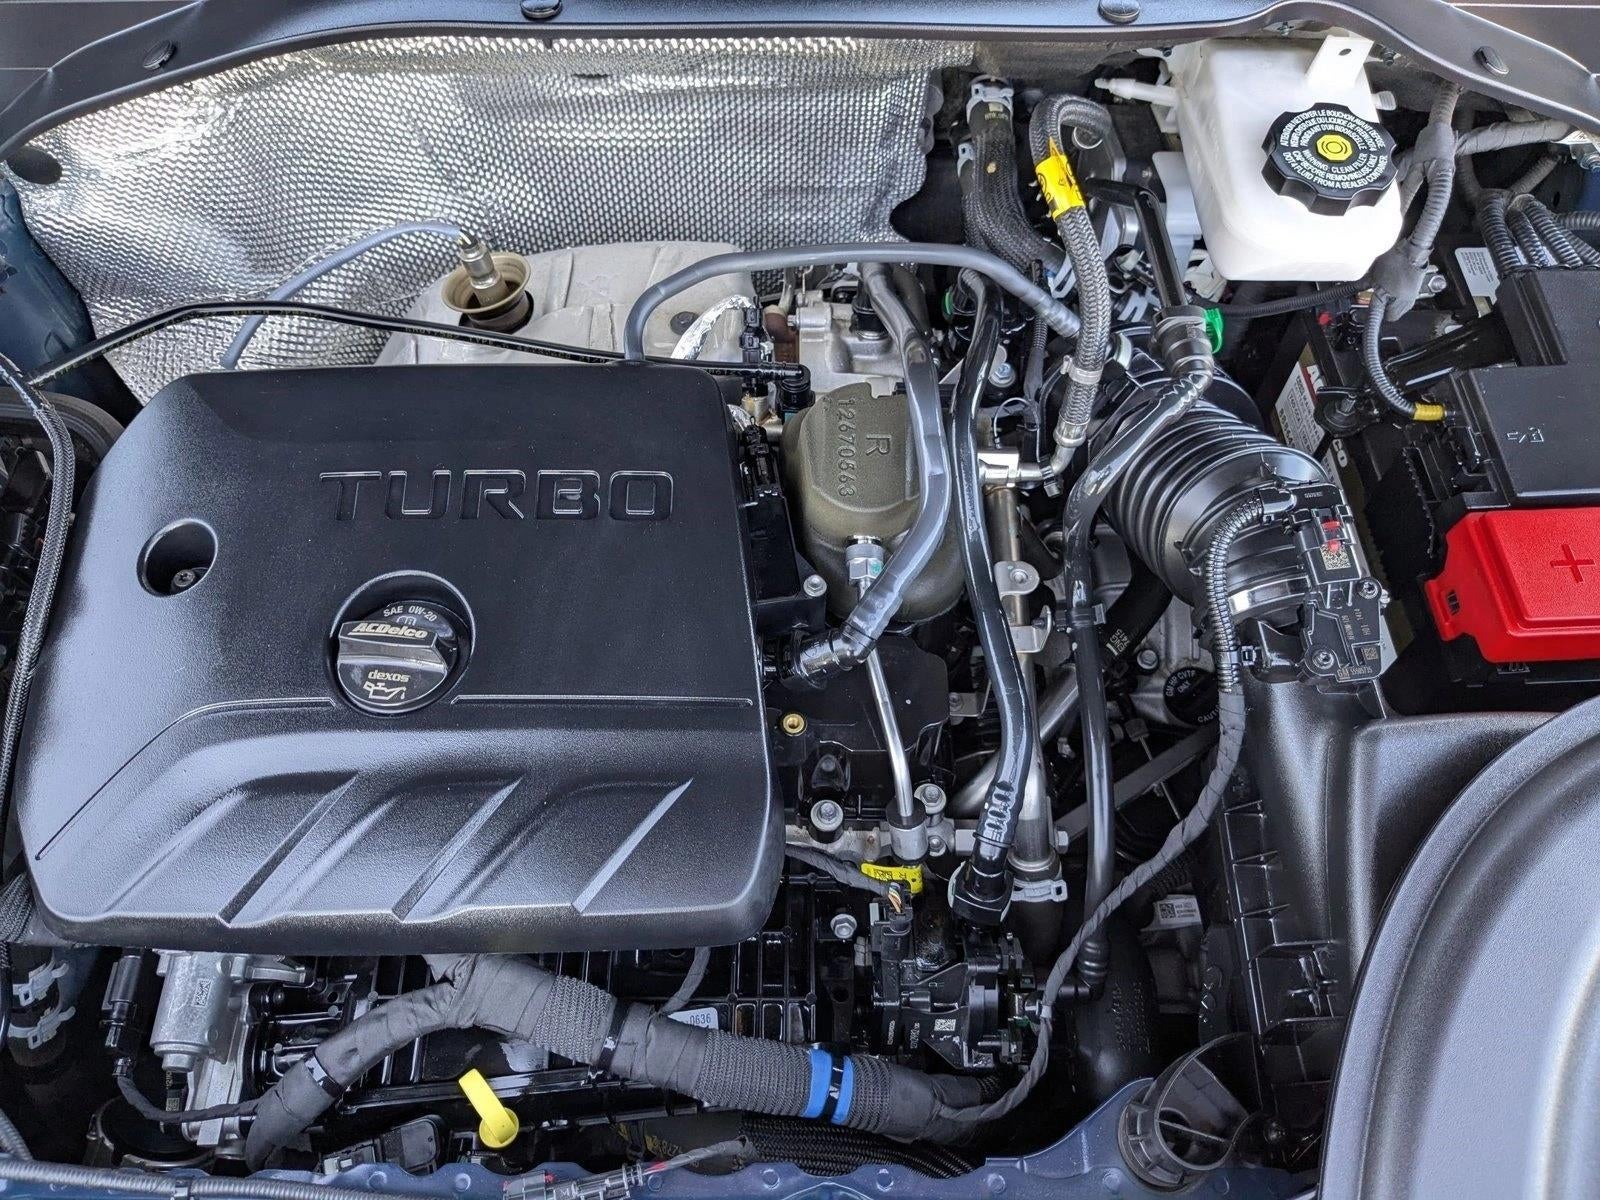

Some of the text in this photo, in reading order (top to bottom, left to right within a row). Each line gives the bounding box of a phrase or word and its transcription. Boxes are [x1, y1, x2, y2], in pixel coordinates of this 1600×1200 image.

[1326, 110, 1356, 122] BOUCHON
[1293, 151, 1306, 163] CAP
[1300, 161, 1327, 179] BEFORE
[1293, 165, 1315, 181] FLUID
[1312, 176, 1335, 188] FROM
[1341, 178, 1369, 189] SEALED
[1365, 155, 1388, 183] CONTAINER
[1331, 165, 1356, 174] CLEAN
[865, 433, 892, 456] R
[319, 469, 674, 520] TURBO
[383, 605, 438, 622] SAE 0W-20
[352, 622, 428, 639] ACDelco
[368, 670, 411, 683] dexos
[1198, 704, 1219, 722] CAUTI
